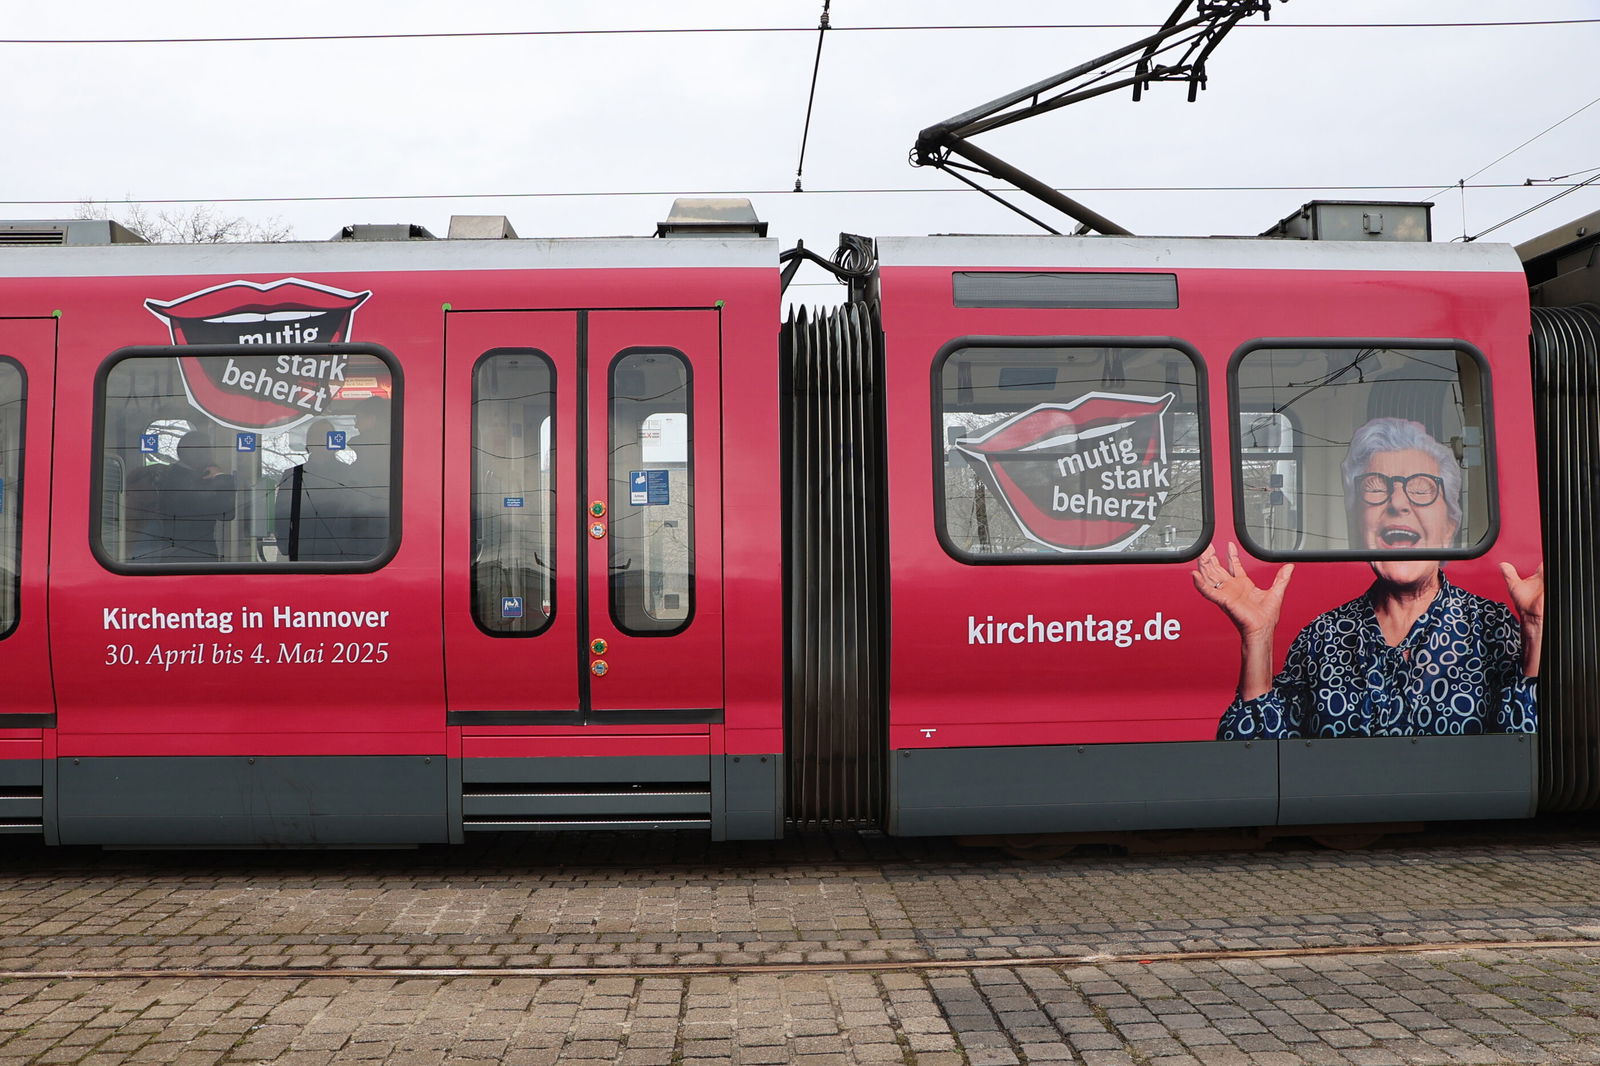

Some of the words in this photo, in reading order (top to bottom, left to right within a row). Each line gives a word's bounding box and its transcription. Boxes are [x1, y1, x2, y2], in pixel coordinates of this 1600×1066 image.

[276, 354, 347, 382] stark
[222, 359, 327, 412] beherzt
[1057, 437, 1138, 477] mutig
[1101, 462, 1170, 490] stark
[1052, 485, 1158, 521] beherzt
[103, 607, 234, 634] Kirchentag
[242, 606, 263, 628] in
[273, 606, 389, 629] Hannover
[968, 612, 1181, 648] kirchentag.de
[105, 644, 140, 665] 30.
[146, 643, 204, 671] April
[211, 643, 244, 665] bis
[250, 643, 271, 664] 4.
[276, 643, 325, 664] Mai
[331, 642, 389, 664] 2025
